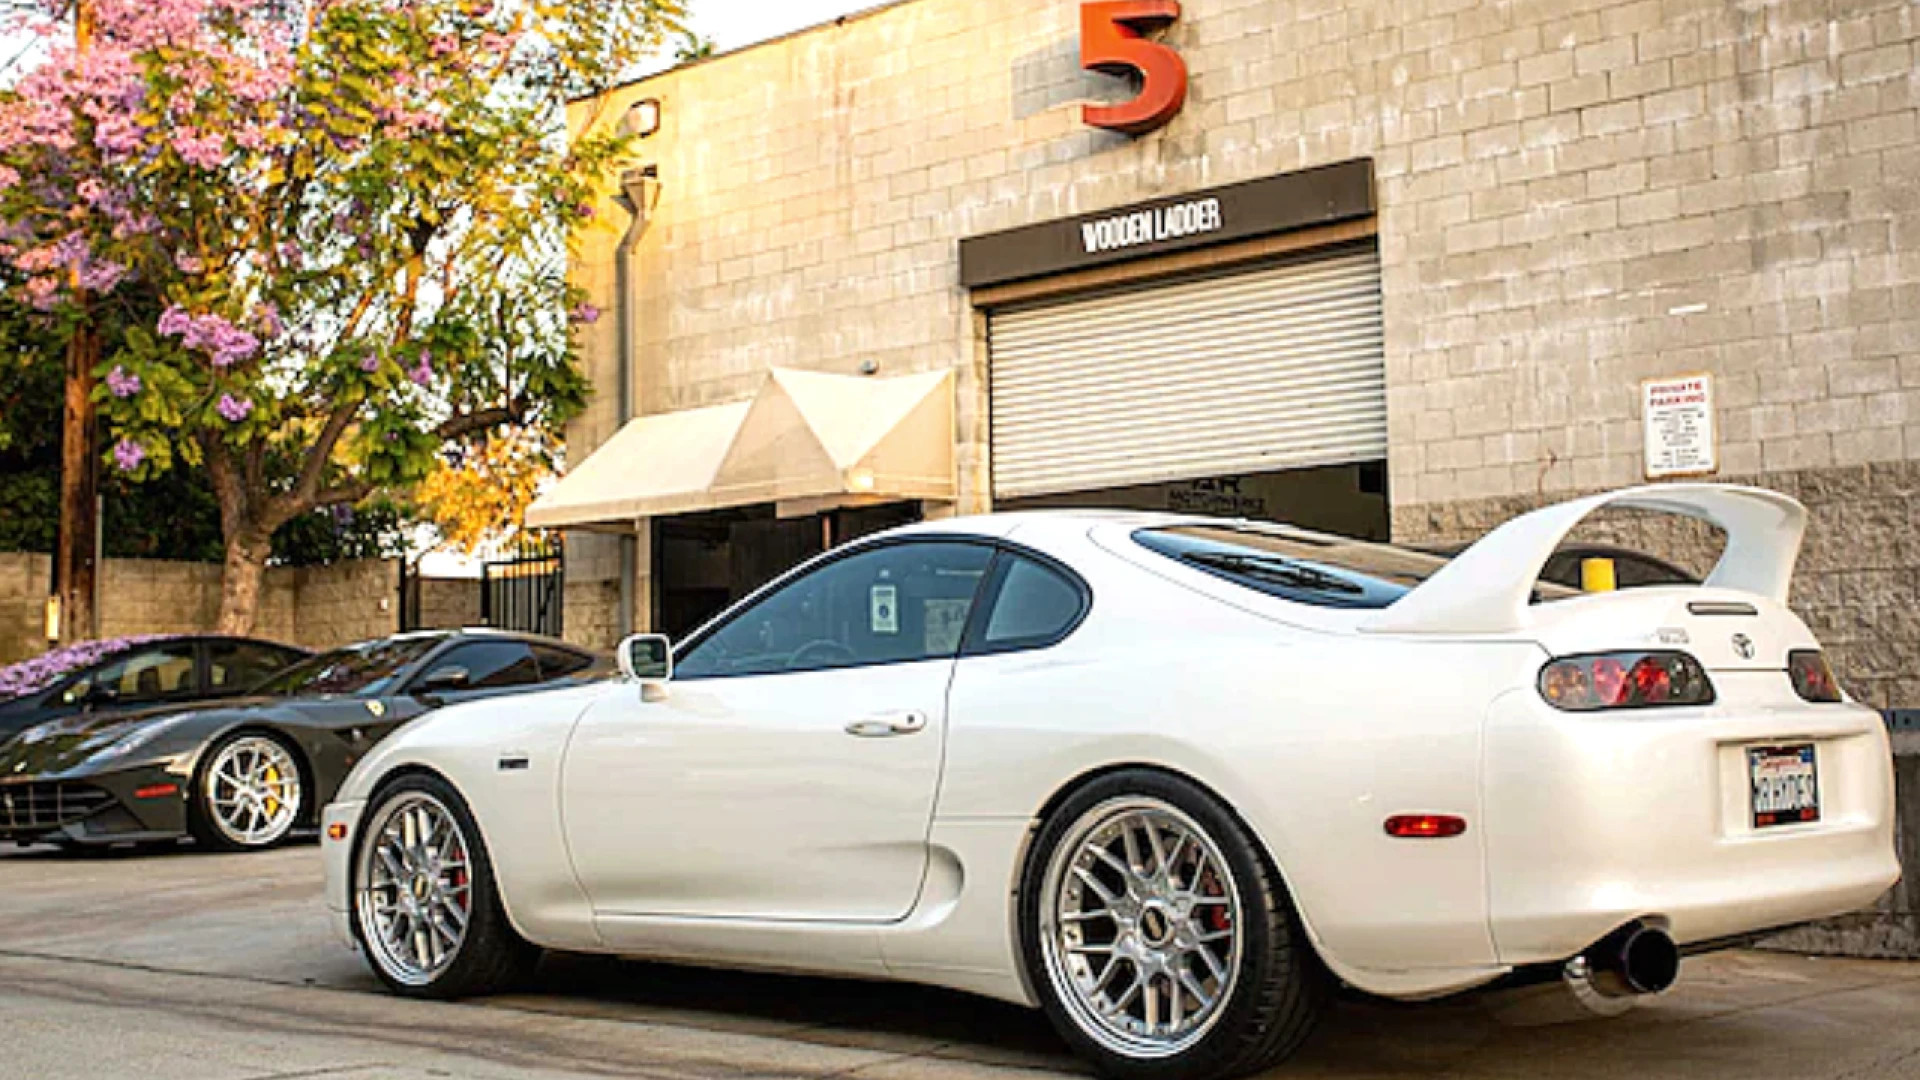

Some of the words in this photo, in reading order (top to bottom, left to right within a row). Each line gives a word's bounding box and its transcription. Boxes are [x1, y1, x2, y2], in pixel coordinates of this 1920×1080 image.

[1080, 0, 1187, 135] 5
[1082, 210, 1153, 253] WOODEN
[1154, 198, 1222, 240] LADDER
